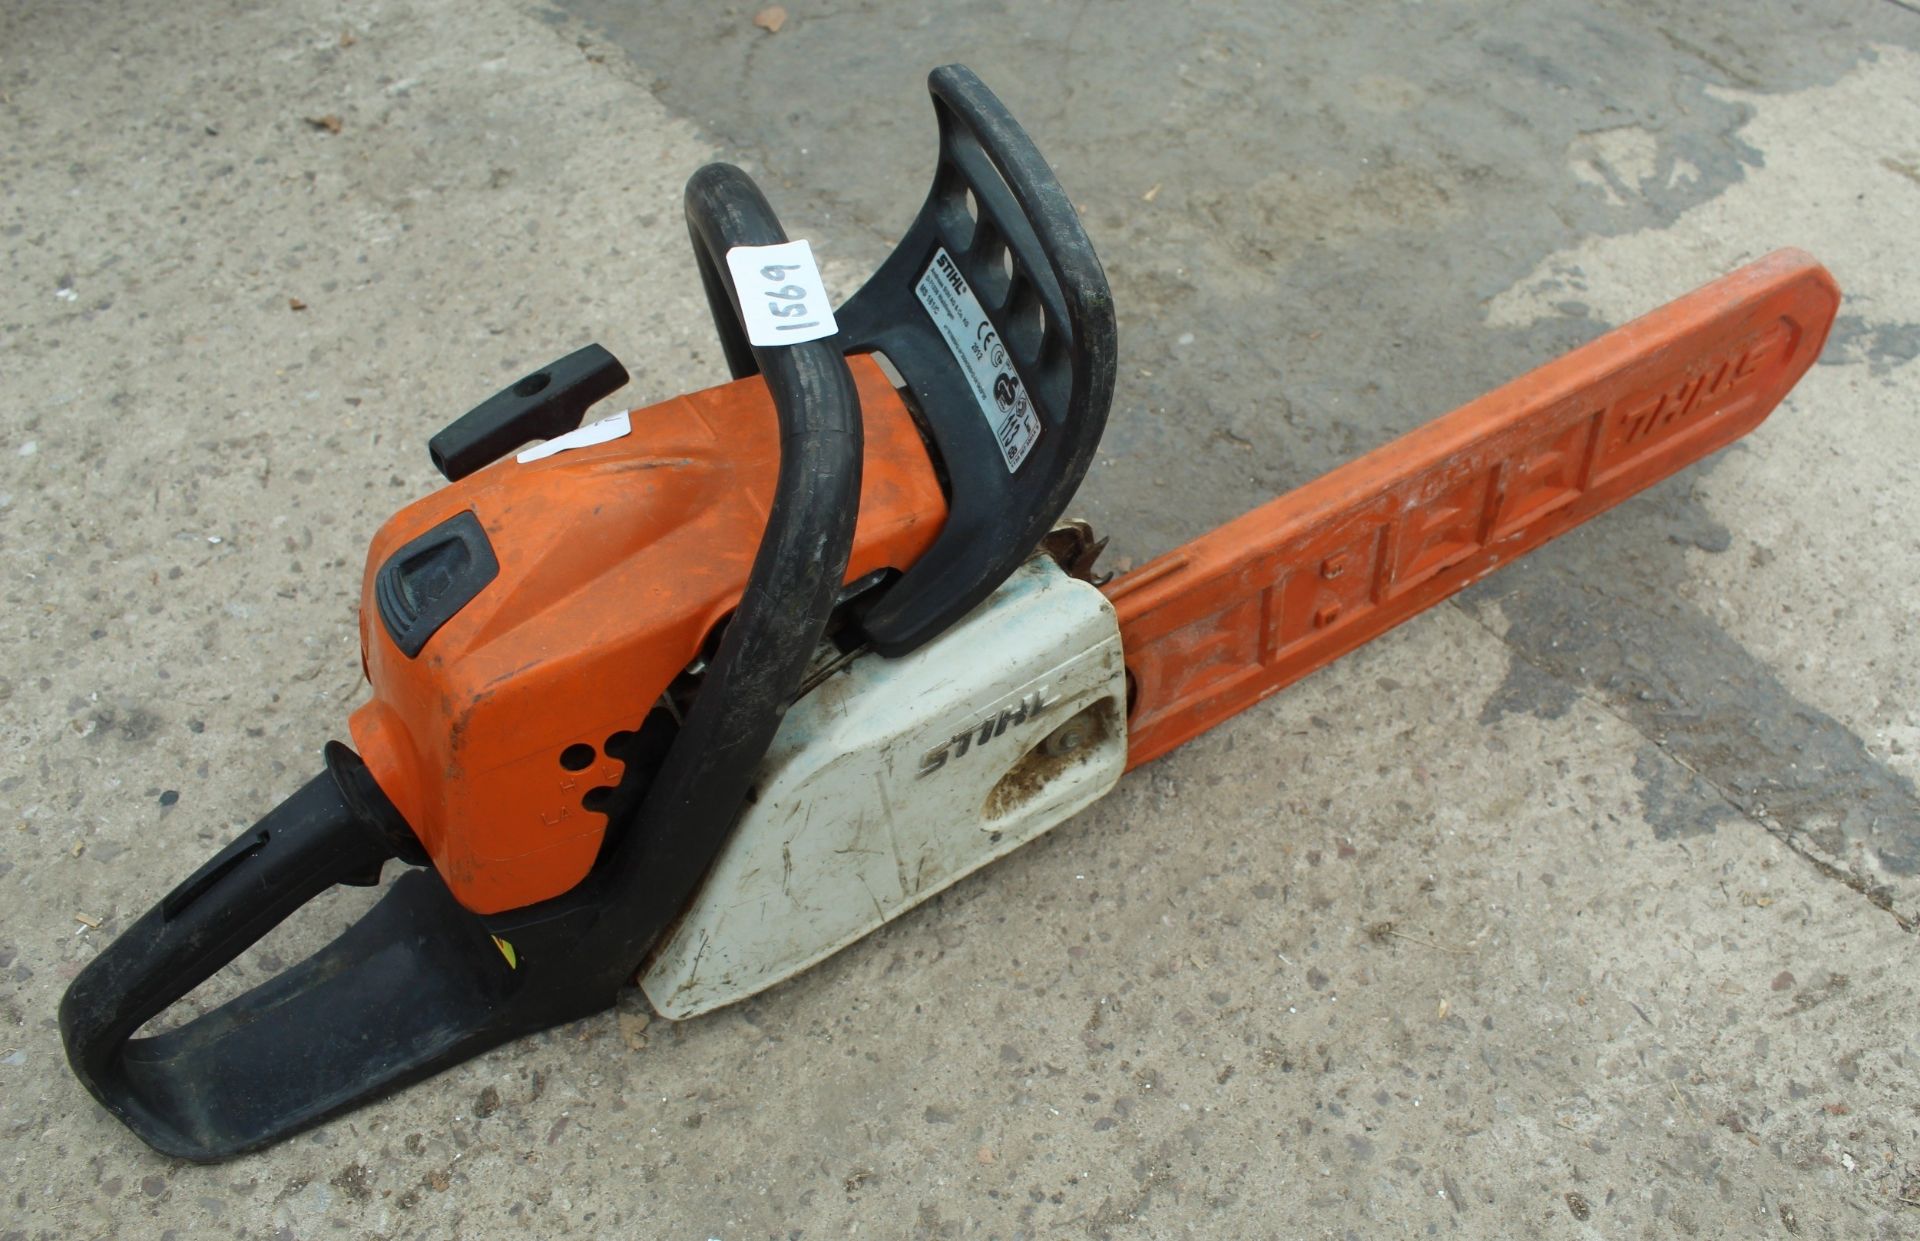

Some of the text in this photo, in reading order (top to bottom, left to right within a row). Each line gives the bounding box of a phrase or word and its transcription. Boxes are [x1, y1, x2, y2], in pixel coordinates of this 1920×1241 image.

[760, 264, 820, 331] 1569
[1000, 413, 1020, 447] 113
[916, 685, 1062, 780] STIHL
